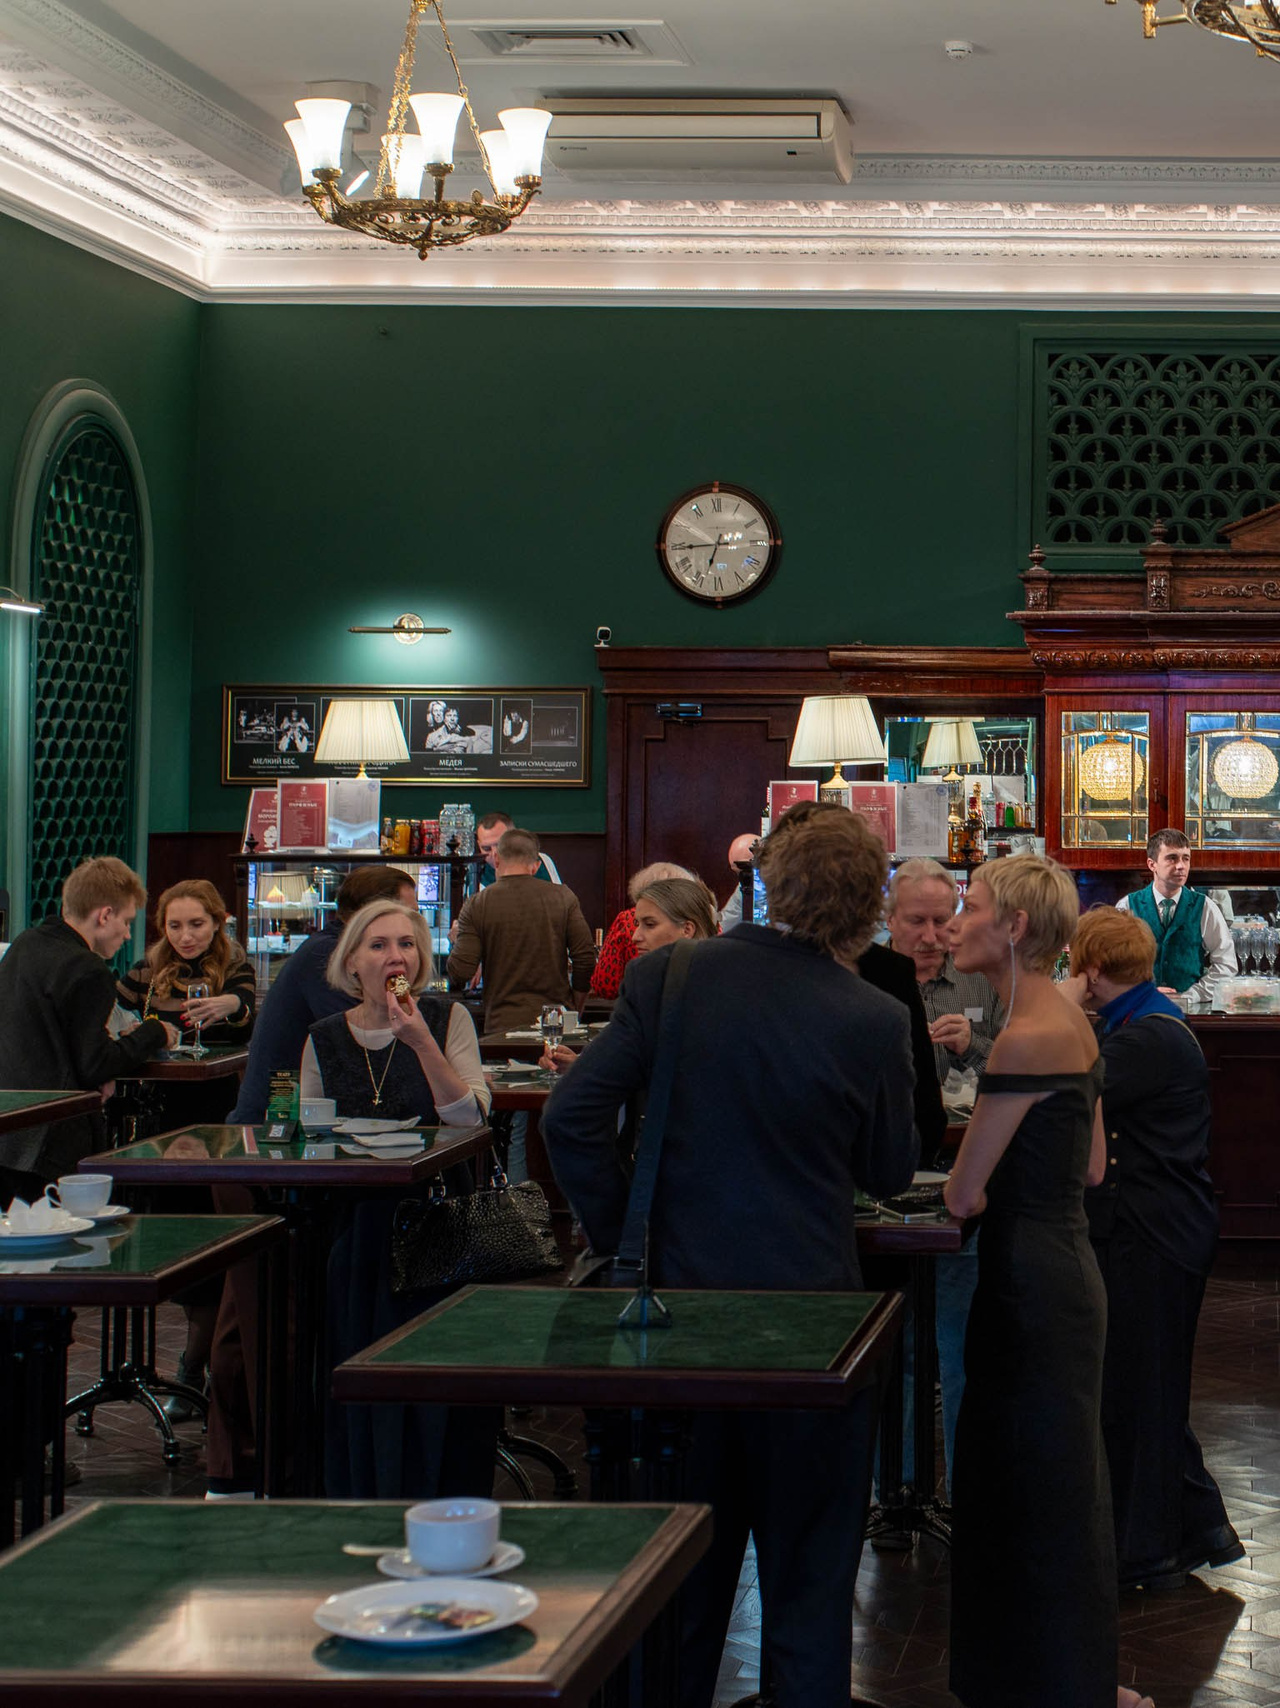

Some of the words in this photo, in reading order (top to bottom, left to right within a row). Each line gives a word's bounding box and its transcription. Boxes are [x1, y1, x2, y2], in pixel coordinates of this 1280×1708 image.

[253, 756, 282, 765] МЕЛКИЙ
[439, 759, 463, 767] МЕДЕЯ
[500, 760, 527, 768] ЗАПИСКИ
[528, 760, 578, 769] СУМАСШЕДШЕГО
